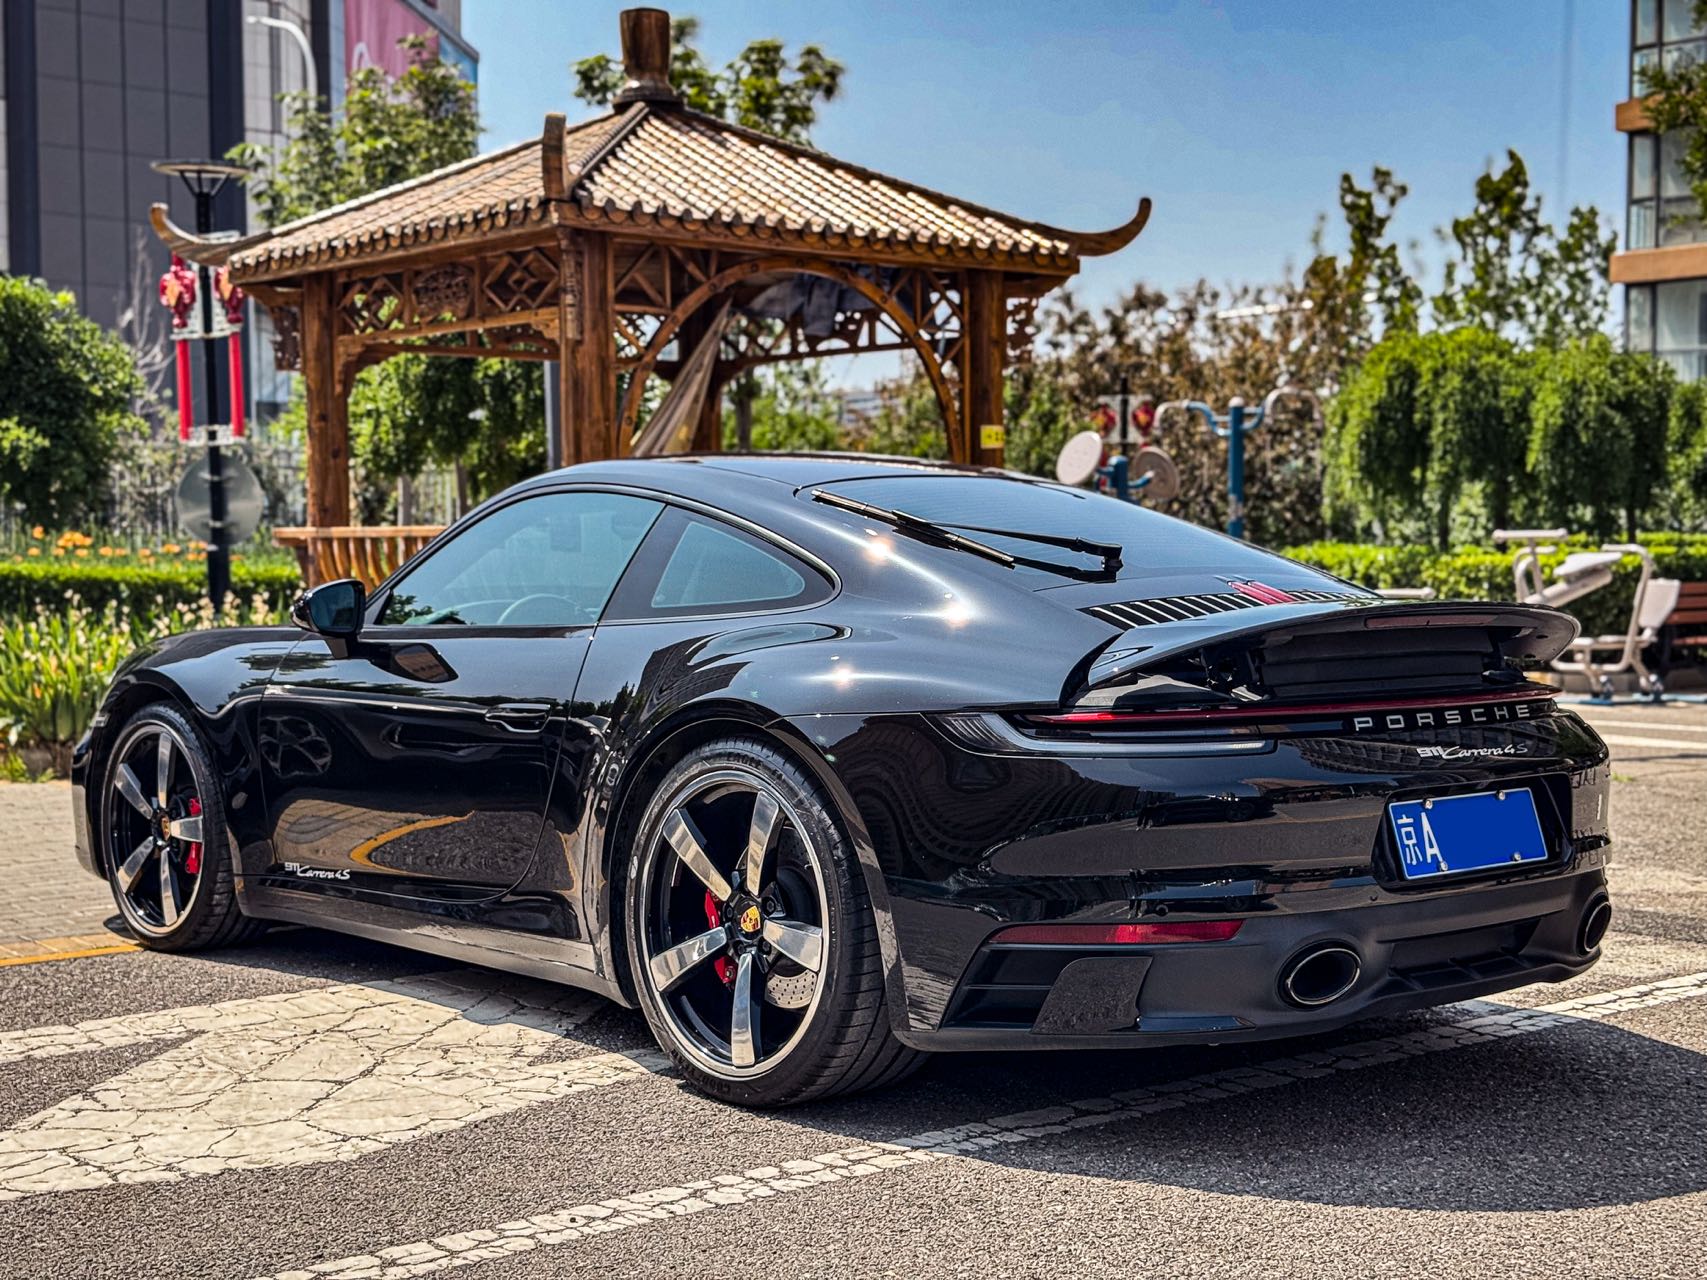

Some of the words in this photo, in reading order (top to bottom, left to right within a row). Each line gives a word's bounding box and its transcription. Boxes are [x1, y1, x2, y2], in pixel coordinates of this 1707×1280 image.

[1353, 704, 1530, 731] PORSCHE
[1417, 746, 1444, 758] 911
[1442, 746, 1503, 760] Carrera
[284, 862, 300, 872] 911
[297, 865, 335, 879] Carrera
